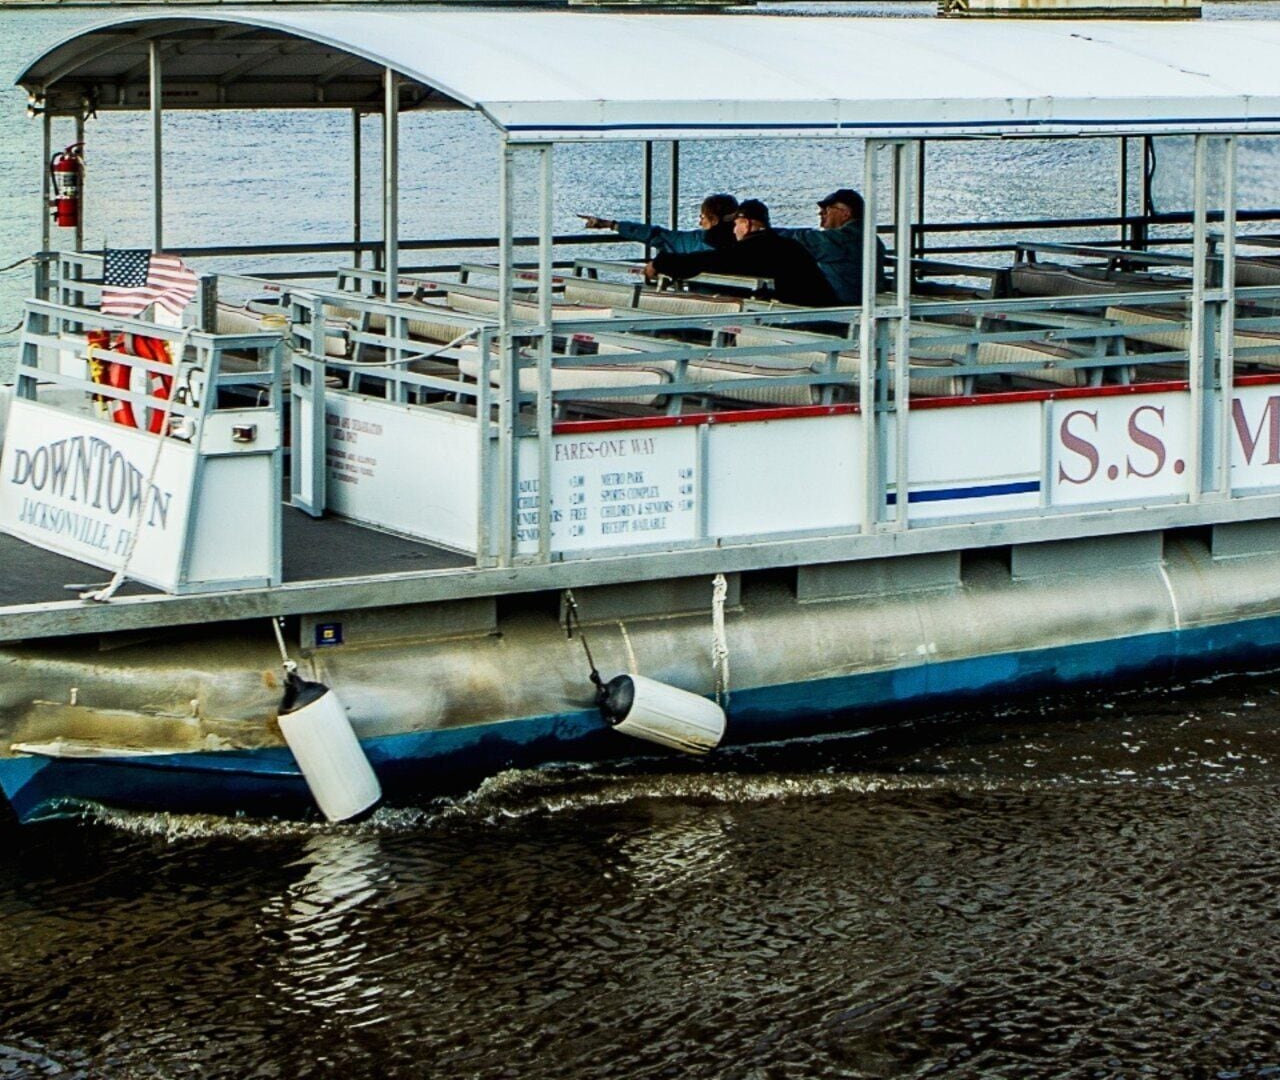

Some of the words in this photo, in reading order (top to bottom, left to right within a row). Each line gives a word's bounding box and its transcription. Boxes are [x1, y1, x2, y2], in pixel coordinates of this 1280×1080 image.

[11, 435, 172, 530] DOWNTOWN
[555, 440, 626, 461] FARES-ONE
[631, 438, 657, 455] WAY
[1058, 405, 1186, 485] S.S.
